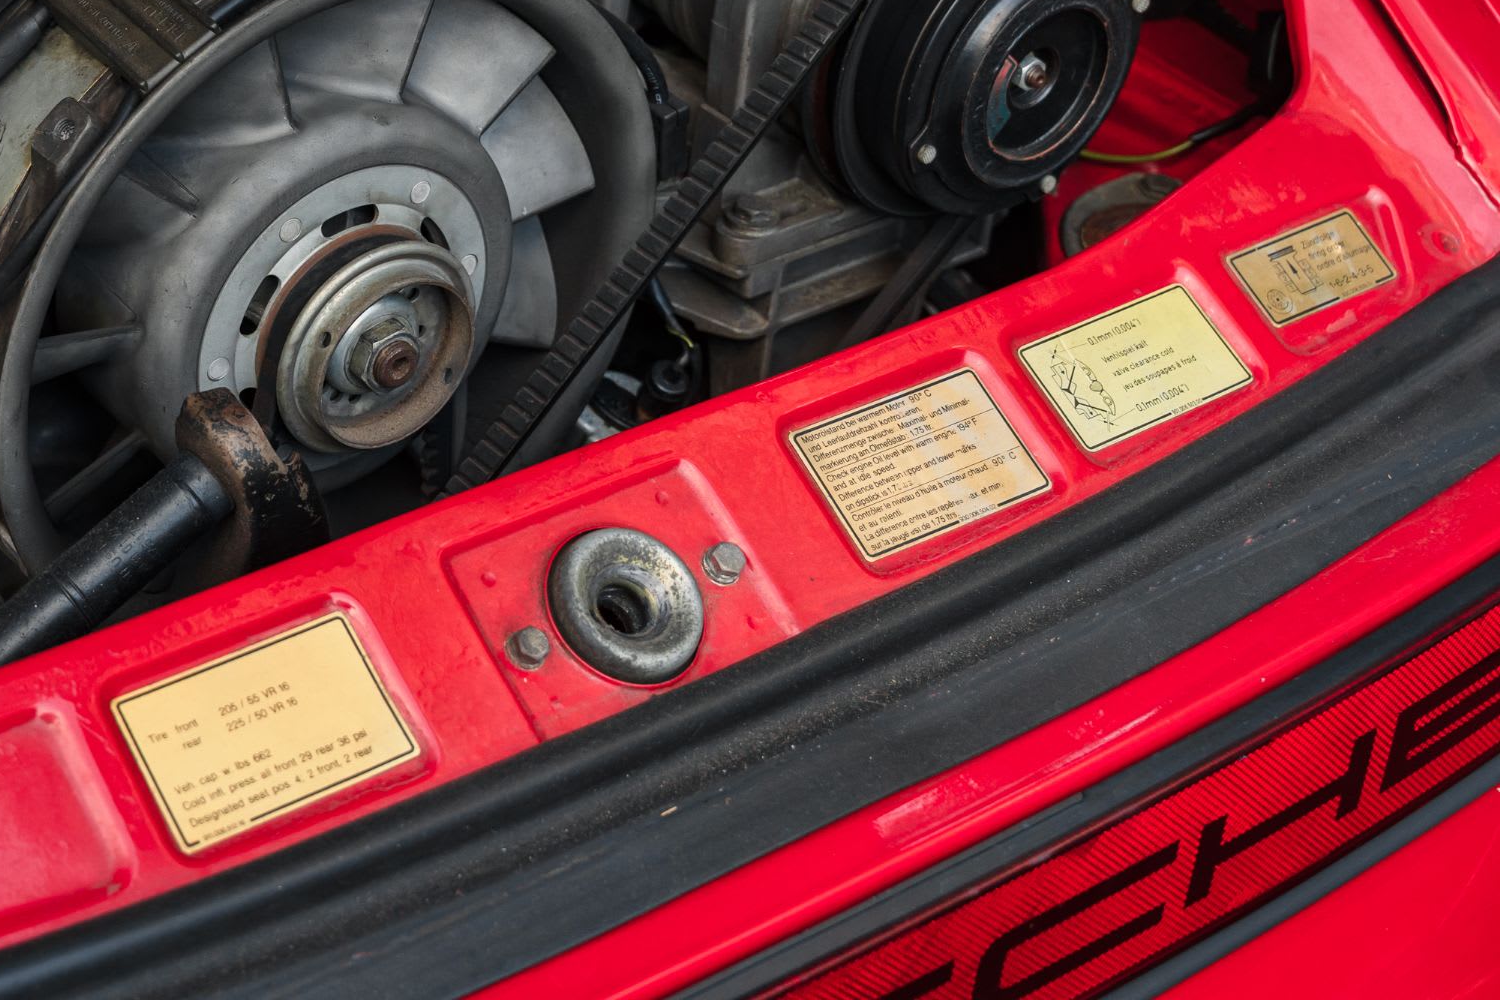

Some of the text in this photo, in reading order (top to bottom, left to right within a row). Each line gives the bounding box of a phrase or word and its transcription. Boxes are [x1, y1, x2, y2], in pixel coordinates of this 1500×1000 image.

[1100, 339, 1148, 363] Ventilspiel kalt
[1112, 346, 1174, 376] valve clearance cold
[1123, 382, 1133, 392] jeu
[1133, 377, 1145, 386] des
[1145, 364, 1176, 380] soupapes
[1180, 354, 1196, 365] froid
[844, 419, 856, 427] bei
[856, 408, 886, 422] warmem
[923, 389, 931, 397] C
[807, 421, 878, 452] und Leerlaufdrehzahl
[812, 398, 968, 462] Differenzmenge Maximal- und Minimal-
[819, 453, 859, 471] markierung
[857, 448, 870, 457] am
[909, 425, 924, 436] 1,75
[826, 469, 849, 482] Check
[849, 460, 873, 474] engine
[872, 455, 883, 464] Oil
[882, 449, 900, 460] level
[899, 444, 914, 454] with
[970, 417, 976, 425] F
[832, 480, 847, 491] and
[848, 477, 857, 485] at
[857, 472, 871, 481] idle
[837, 483, 874, 501] Difference
[923, 457, 937, 468] and
[935, 451, 954, 463] lower
[851, 505, 883, 521] Contrôler
[891, 493, 915, 506] niveau
[942, 472, 966, 486] moteur
[967, 463, 988, 476] chaud
[1008, 451, 1016, 459] C
[844, 502, 855, 511] on
[854, 492, 881, 507] dipstick
[858, 523, 867, 531] et
[863, 533, 875, 541] La
[925, 508, 938, 516] les
[870, 541, 882, 551] sur
[889, 531, 909, 544] jauge
[921, 522, 931, 530] de
[930, 514, 946, 526] 1,75
[147, 732, 167, 742] Tire
[174, 719, 198, 732] front
[218, 702, 237, 716] 205
[246, 693, 260, 704] 55
[261, 686, 277, 698] VR
[278, 682, 289, 691] 16
[182, 736, 201, 748] rear
[226, 717, 245, 732] 225
[253, 708, 267, 719] 50
[268, 701, 284, 713] VR
[286, 696, 297, 706] 16
[181, 730, 367, 810] Cold all front 29 rear 36 psi
[234, 760, 250, 769] lbs
[252, 750, 270, 762] 662
[188, 799, 245, 827] Designated
[248, 789, 269, 803] seat
[307, 768, 314, 778] 2
[343, 753, 351, 763] 2
[354, 745, 372, 758] rear
[881, 652, 1500, 1000] CHE
